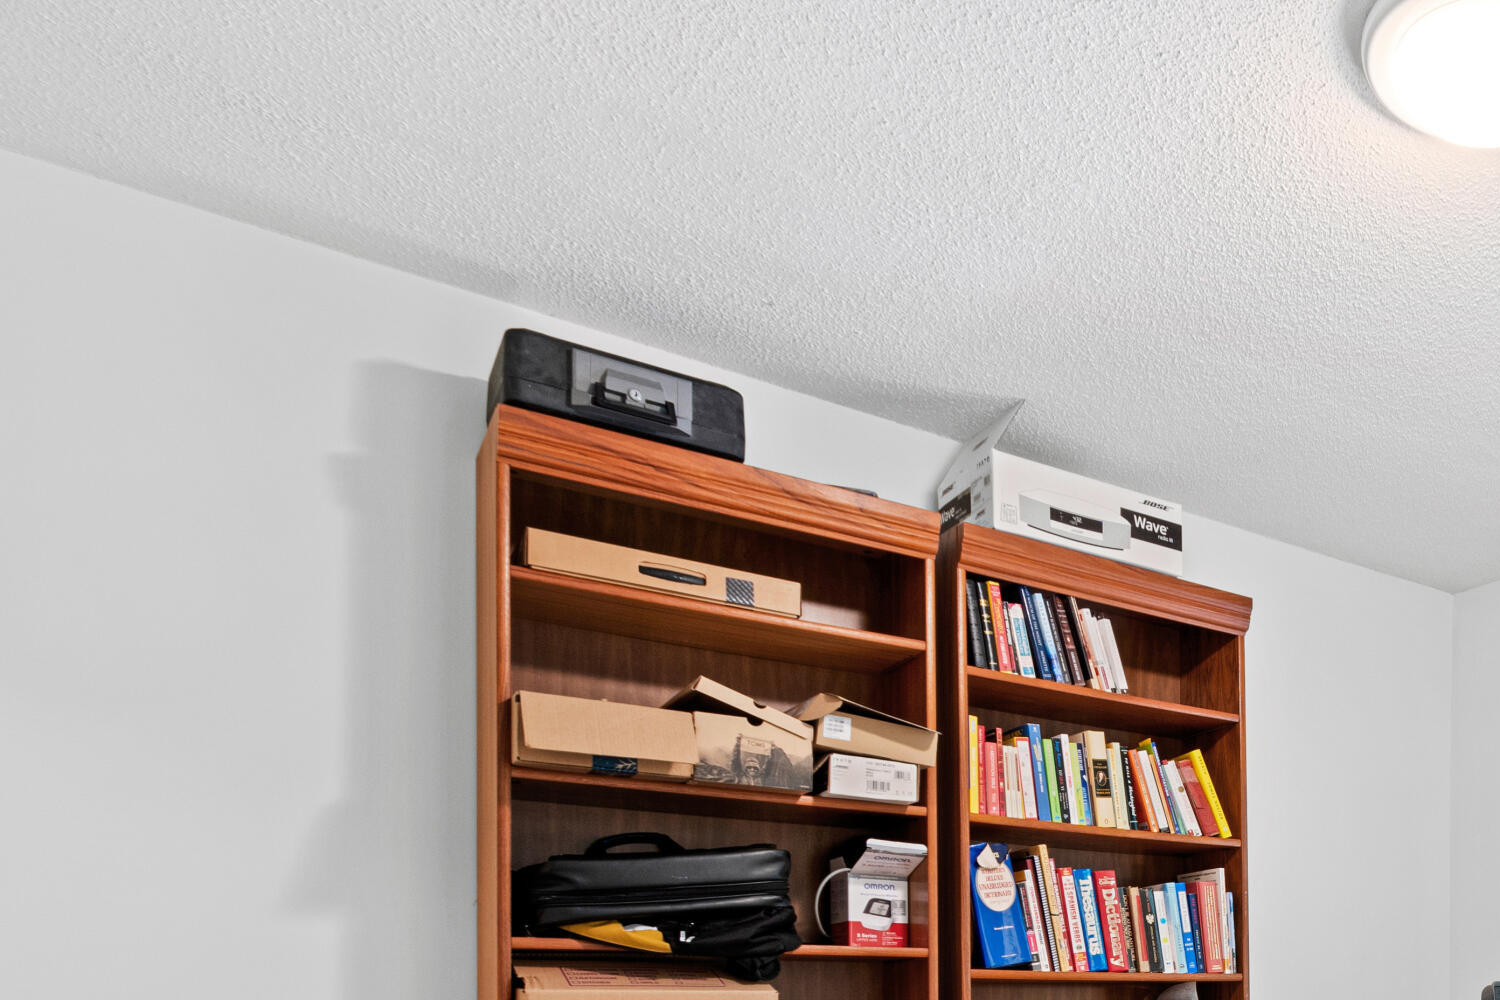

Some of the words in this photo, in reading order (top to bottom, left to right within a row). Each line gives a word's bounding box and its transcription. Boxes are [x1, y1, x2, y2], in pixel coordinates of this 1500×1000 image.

[1133, 513, 1168, 536] Wave
[863, 882, 896, 891] OMRON
[1066, 890, 1078, 920] SPANISH
[1072, 920, 1082, 944] VERBS
[1078, 874, 1105, 956] Thesaurus
[1102, 887, 1125, 968] Dictionary
